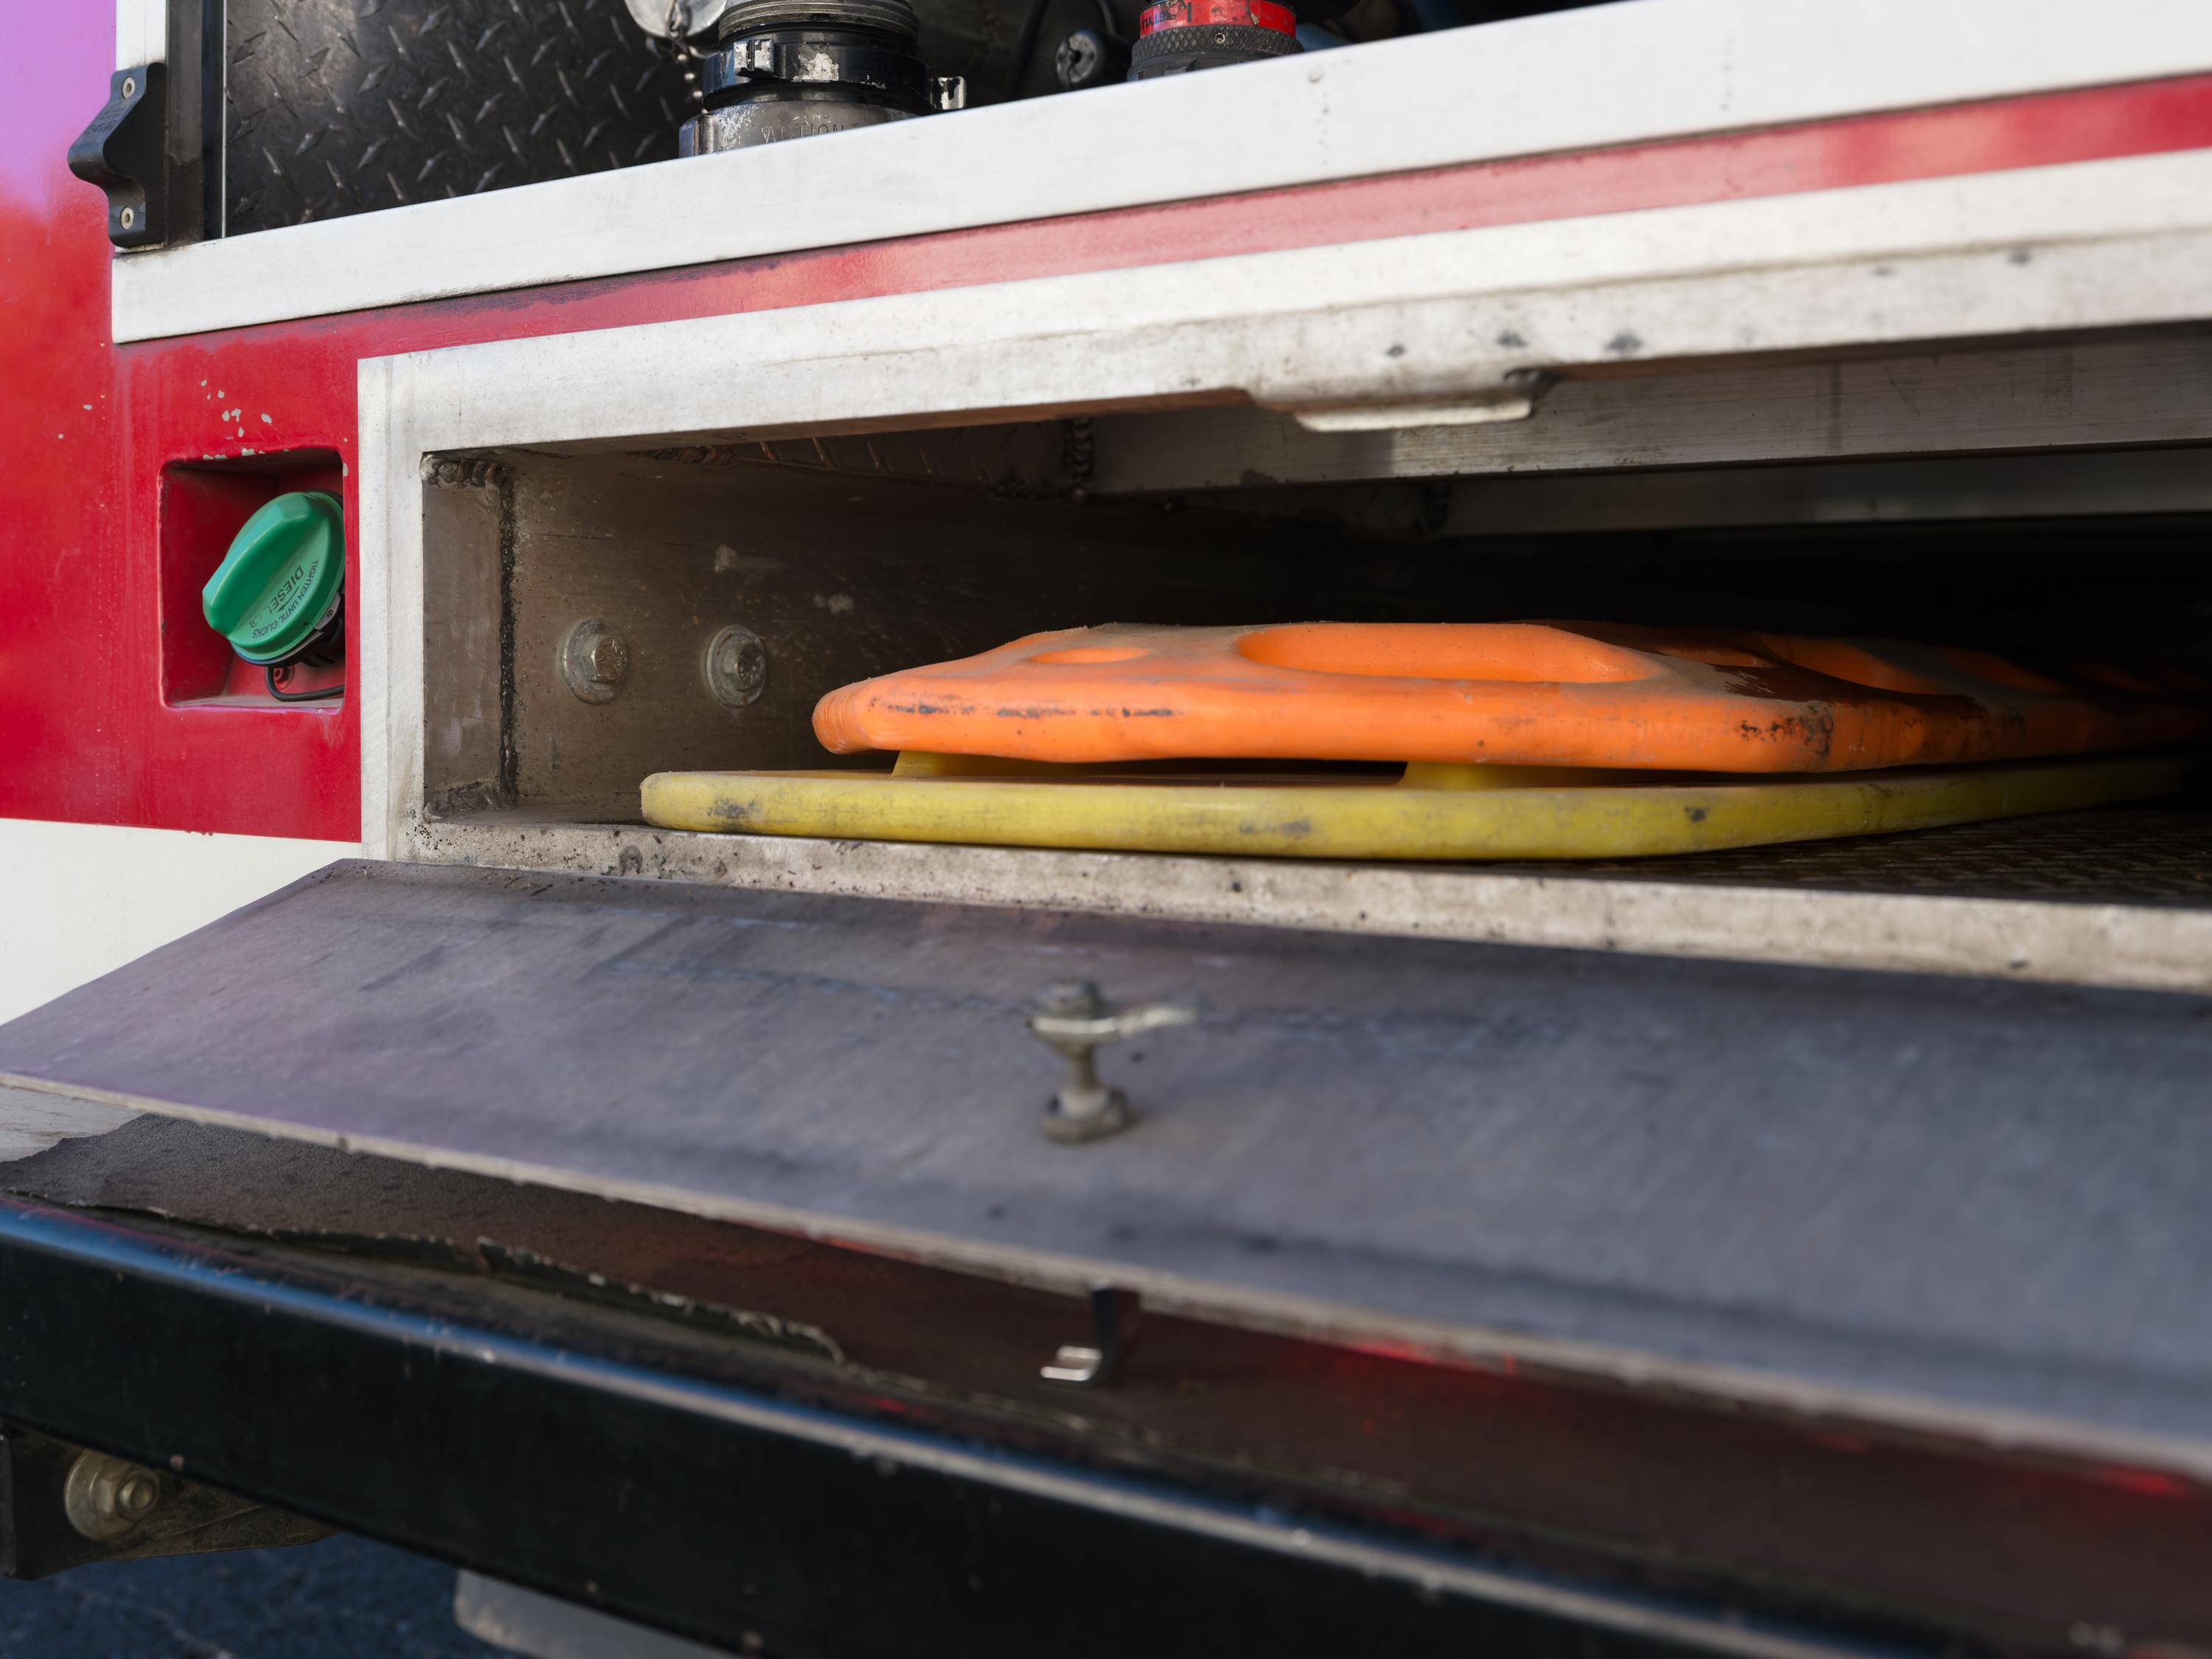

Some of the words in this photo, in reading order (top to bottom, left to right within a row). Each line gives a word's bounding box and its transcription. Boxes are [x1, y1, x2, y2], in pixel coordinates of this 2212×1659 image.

[297, 559, 319, 600] TIGHTEN
[279, 600, 299, 622] UNTIL
[252, 621, 278, 639] CLICKS
